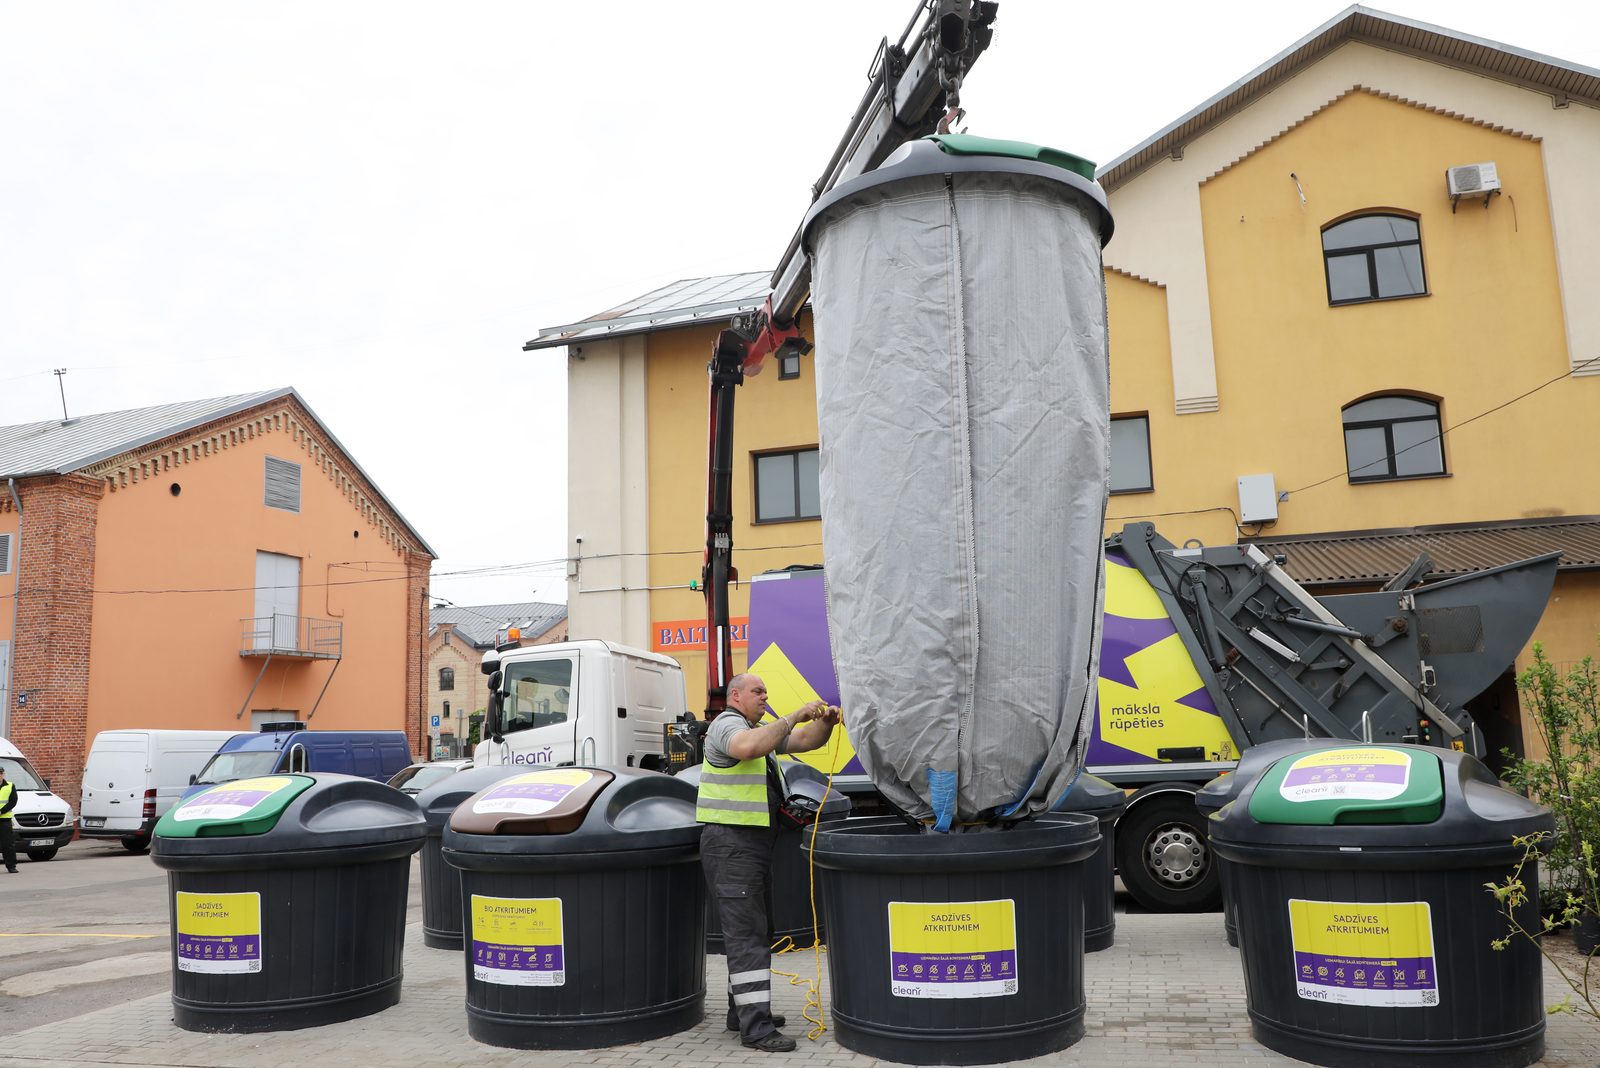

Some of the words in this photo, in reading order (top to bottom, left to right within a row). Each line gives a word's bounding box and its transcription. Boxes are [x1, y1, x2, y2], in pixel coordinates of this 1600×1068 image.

[660, 624, 748, 646] BALTRI
[1112, 704, 1160, 715] māksla
[1110, 717, 1164, 732] rūpēties
[931, 913, 971, 922] SADZĪVES
[1334, 914, 1378, 924] SADZĪVES
[923, 924, 980, 932] ATKRITUMIEM
[1326, 926, 1390, 934] ATKRITUMIEM
